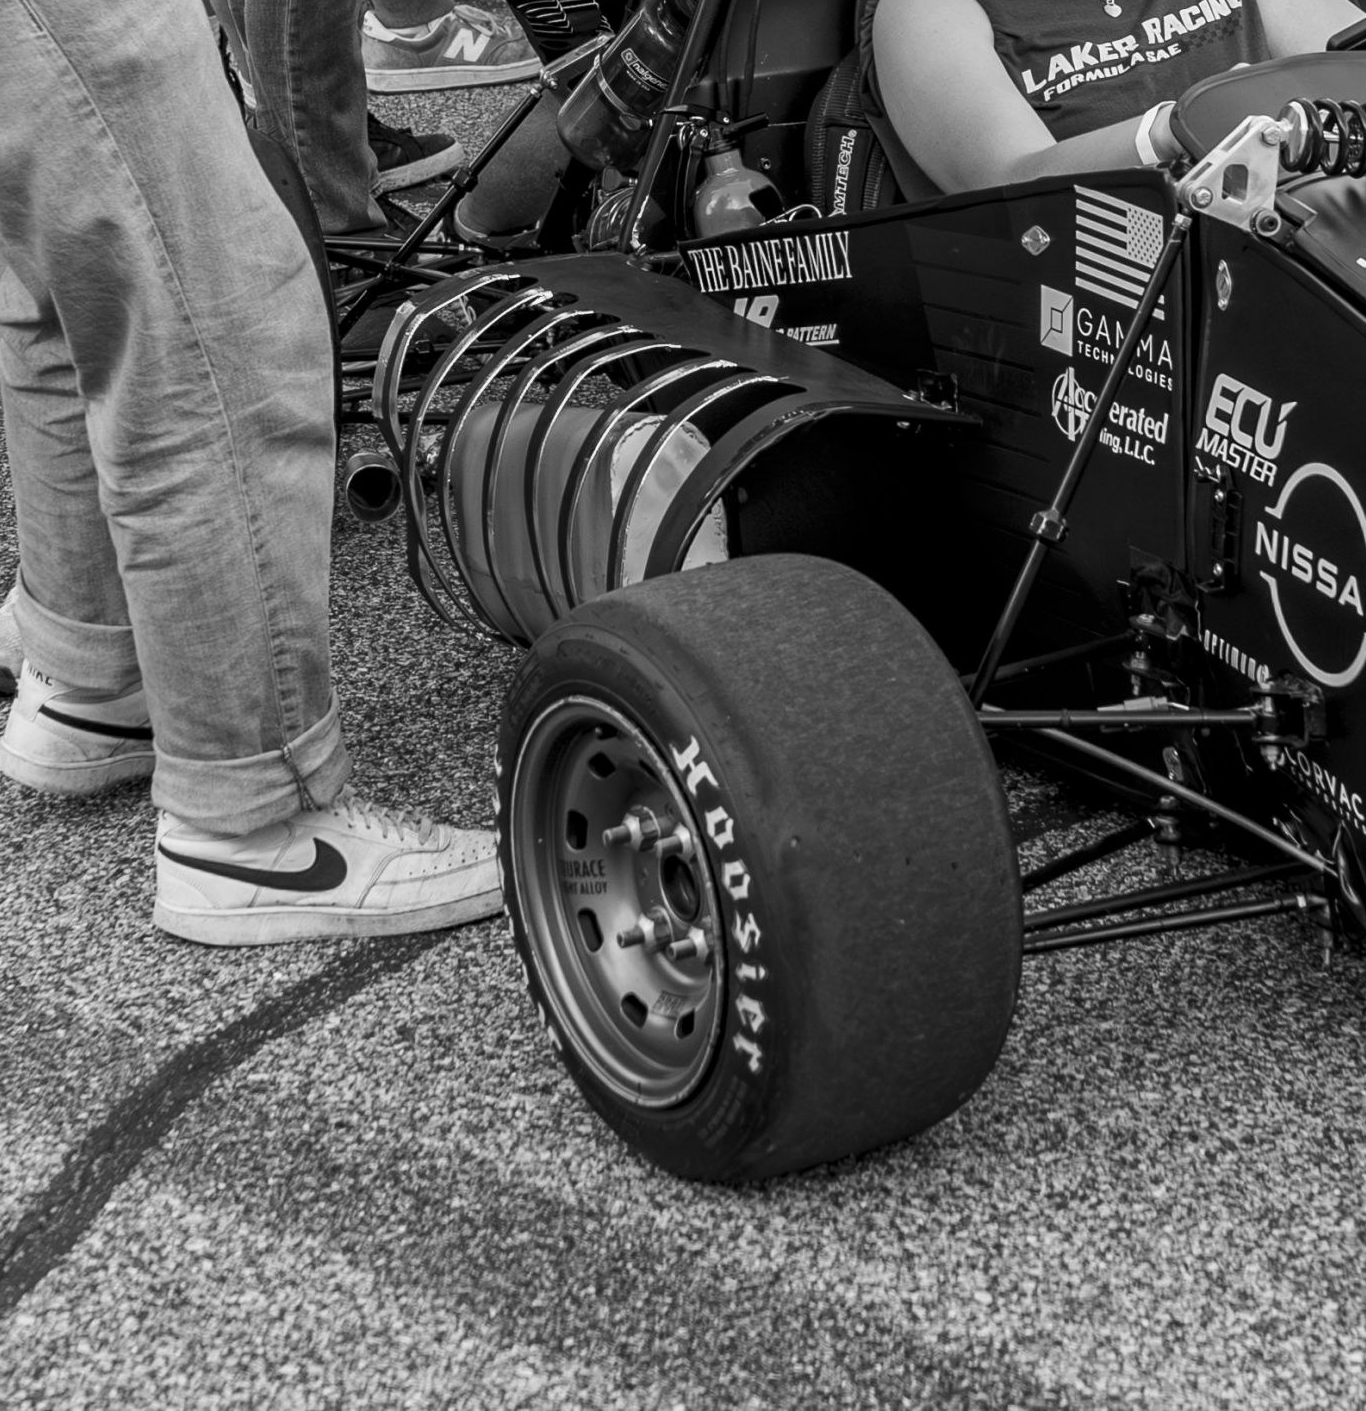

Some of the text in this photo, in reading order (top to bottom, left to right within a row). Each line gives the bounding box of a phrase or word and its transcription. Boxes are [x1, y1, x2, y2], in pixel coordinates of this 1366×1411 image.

[1021, 33, 1140, 94] LAKER
[1043, 42, 1183, 102] FORMULA SAE
[688, 230, 854, 293] THE BAINE FAMILY
[1205, 372, 1298, 461] ECU
[1195, 427, 1278, 488] MASTER
[669, 734, 769, 1075] Hoosier
